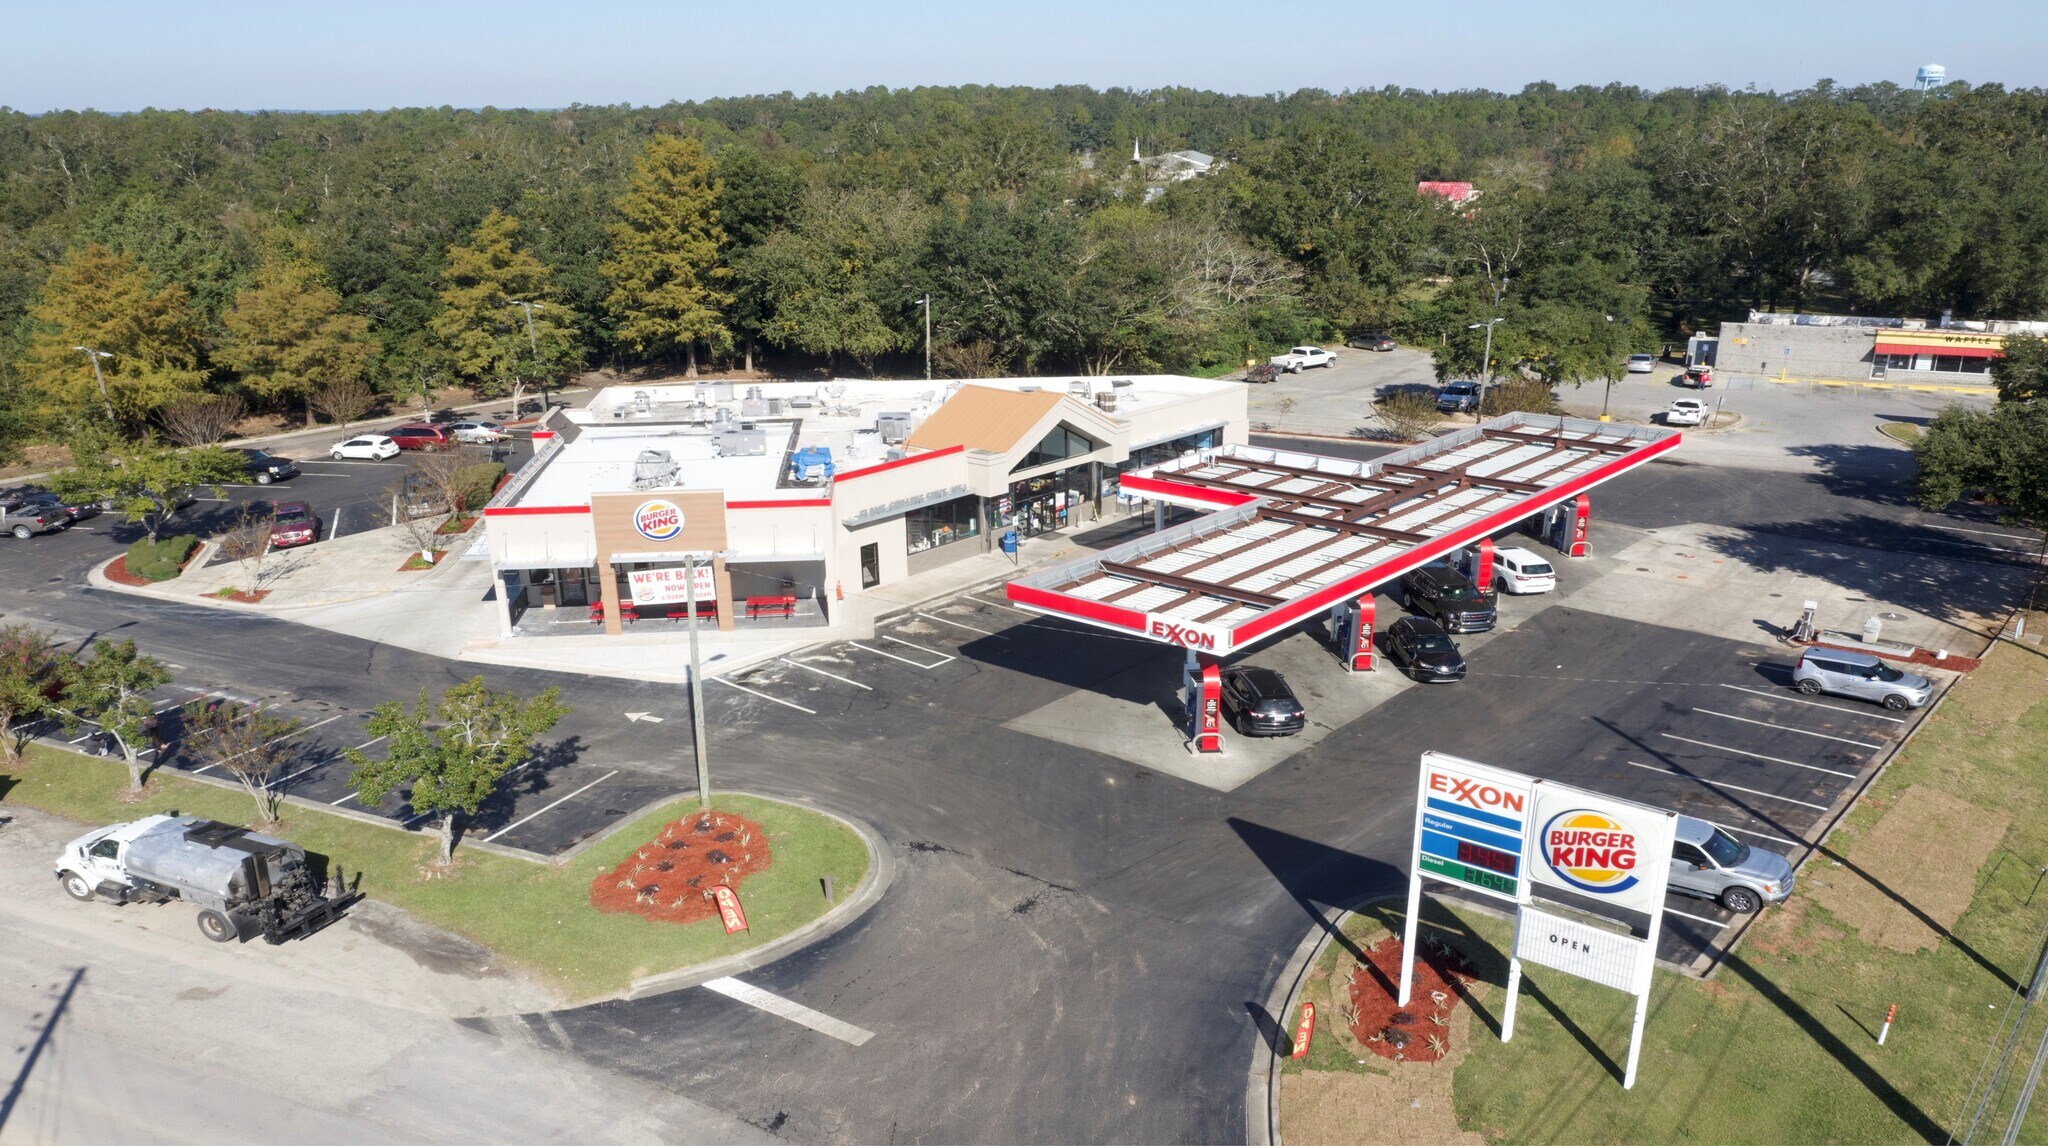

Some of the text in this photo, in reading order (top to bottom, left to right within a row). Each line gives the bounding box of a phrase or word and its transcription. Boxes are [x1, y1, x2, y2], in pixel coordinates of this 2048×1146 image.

[1945, 336, 1991, 345] WAFFLE
[640, 508, 677, 522] BURGER
[643, 515, 679, 532] KING
[633, 568, 709, 584] WE'RE BK!
[664, 583, 685, 593] NOW
[1152, 621, 1215, 648] EXXON
[1430, 772, 1524, 813] EXXON
[1424, 817, 1453, 831] Regular
[1550, 830, 1635, 849] BURGER
[1421, 854, 1444, 867] Diesel
[1551, 847, 1637, 870] KING
[1549, 934, 1590, 954] OPEN
